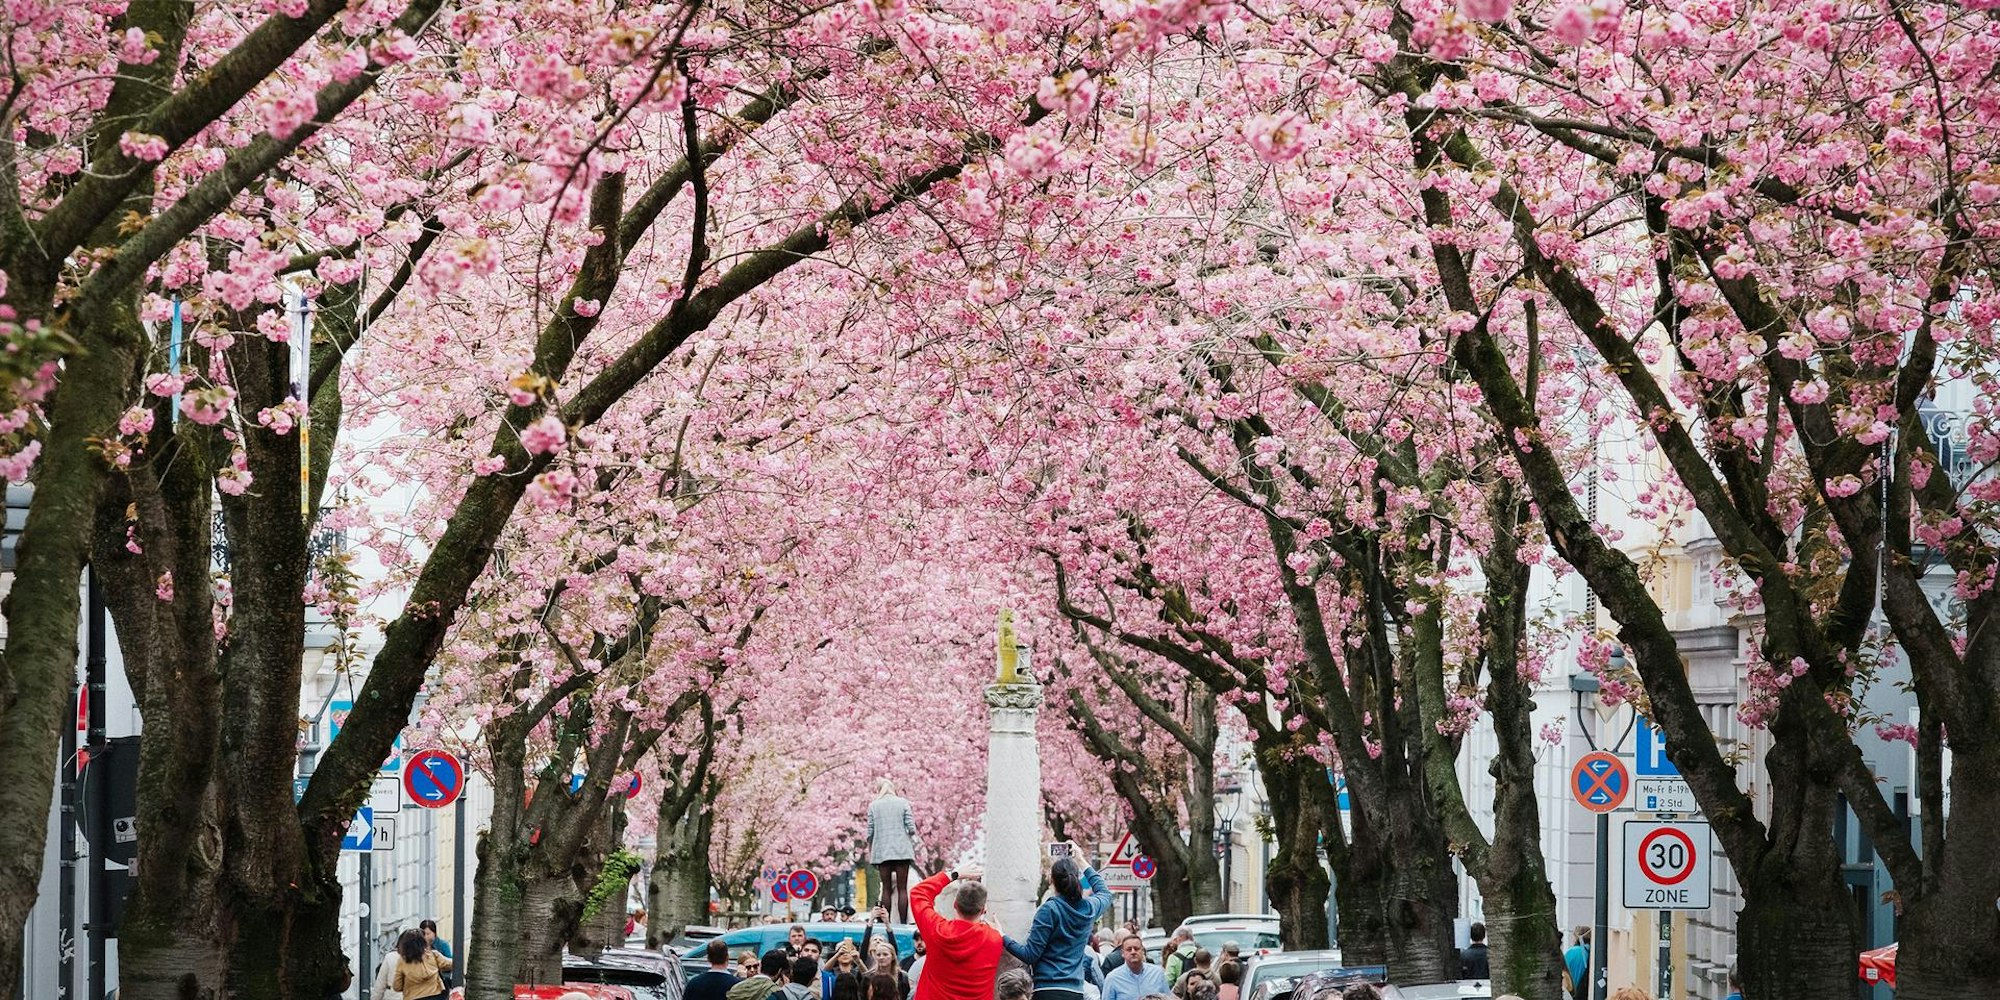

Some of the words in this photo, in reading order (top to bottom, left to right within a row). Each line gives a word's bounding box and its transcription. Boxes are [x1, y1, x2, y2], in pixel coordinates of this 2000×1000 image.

[1643, 785, 1664, 794] Mo-Fr
[1660, 799, 1665, 808] 2
[1651, 843, 1684, 870] 30
[1104, 872, 1132, 880] Zufahrt
[1645, 889, 1689, 903] ZONE
